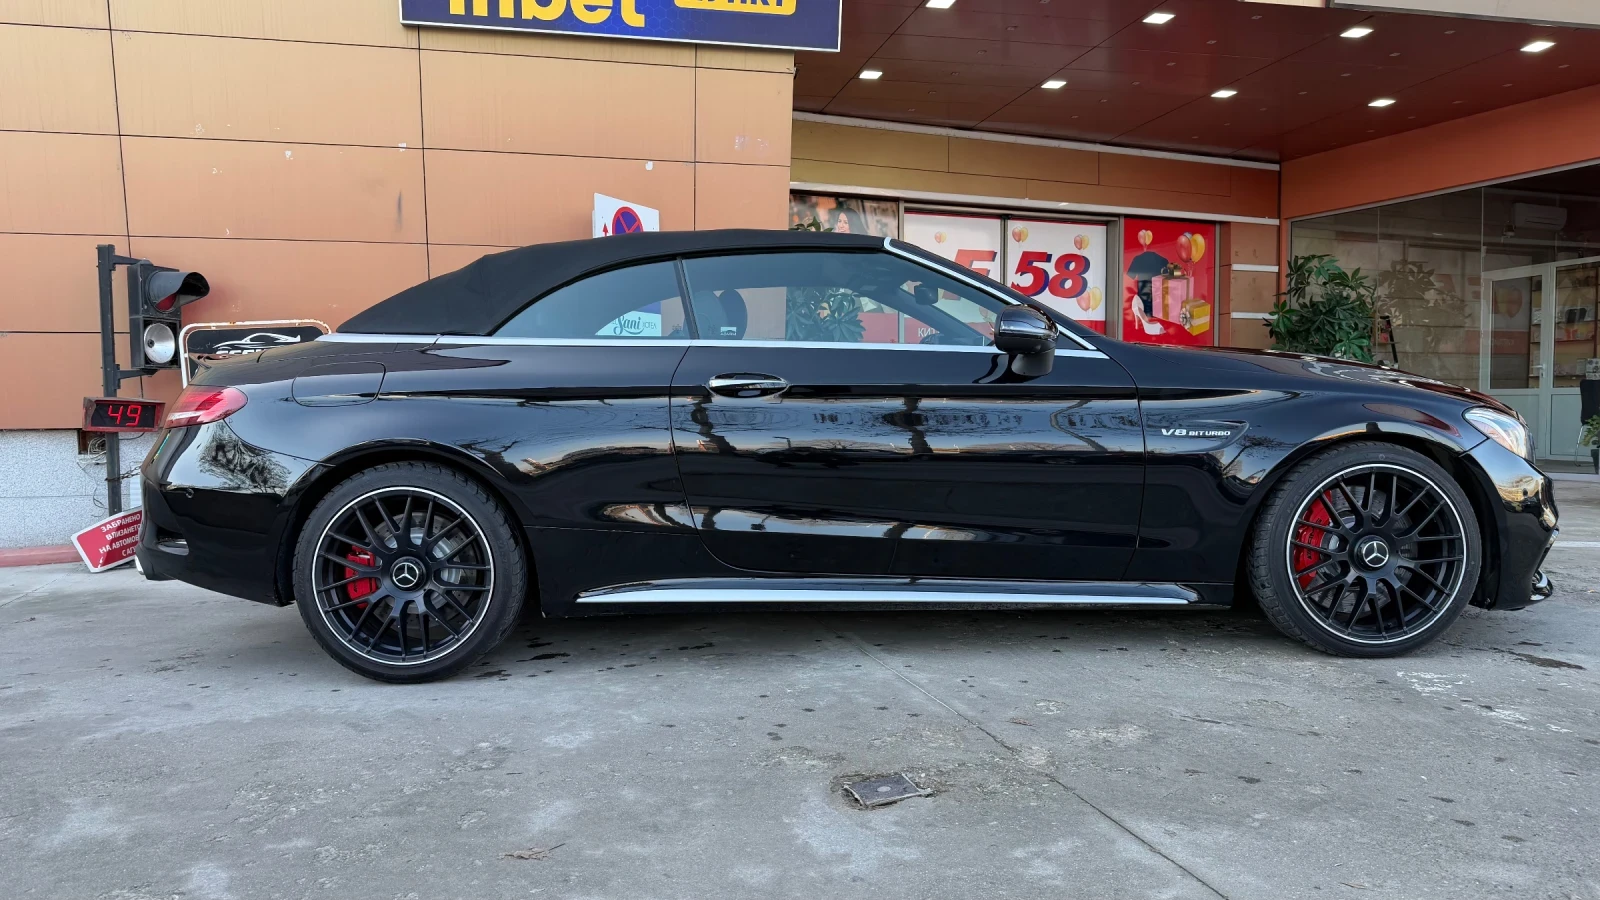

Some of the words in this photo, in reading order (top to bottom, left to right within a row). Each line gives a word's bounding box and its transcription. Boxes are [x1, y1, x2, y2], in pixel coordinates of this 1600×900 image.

[1011, 251, 1090, 299] 58
[613, 316, 641, 335] Sani
[108, 404, 142, 427] 49
[1161, 428, 1187, 436] V8
[100, 513, 141, 533] ЗАБРАНЕНО
[99, 544, 112, 554] НА
[112, 534, 140, 550] АВТОМОБ
